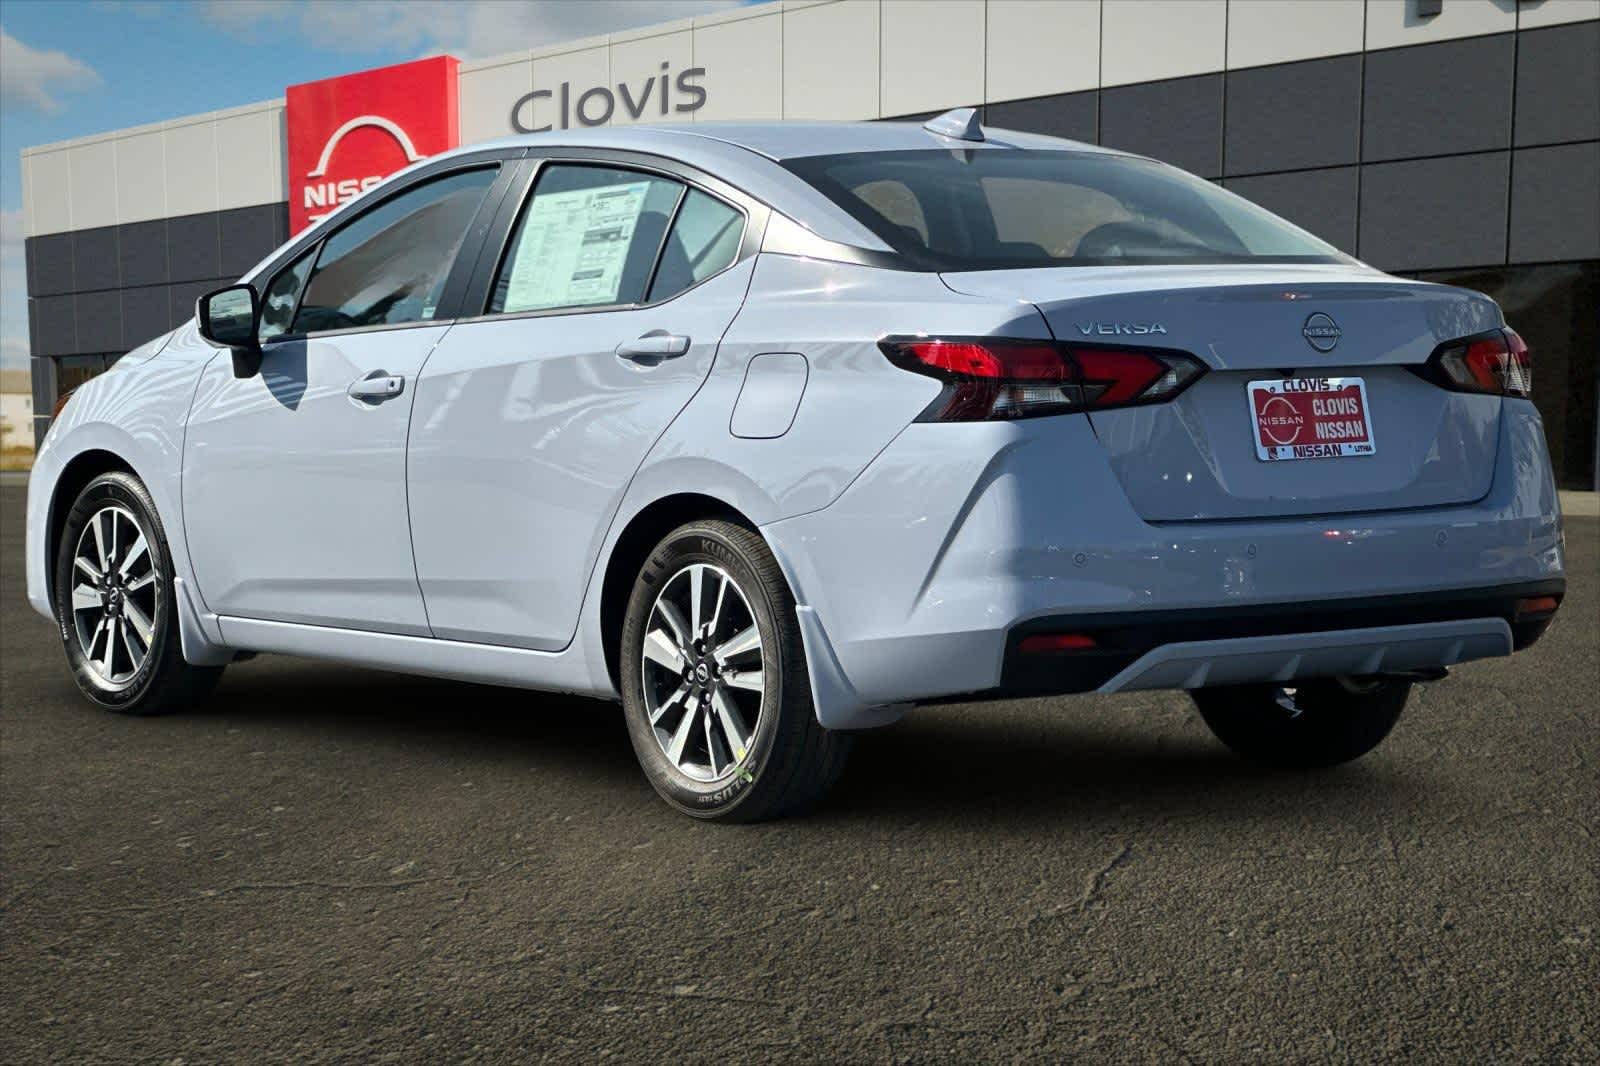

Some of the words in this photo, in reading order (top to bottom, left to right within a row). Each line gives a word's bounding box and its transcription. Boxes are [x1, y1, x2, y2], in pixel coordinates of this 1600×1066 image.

[511, 62, 706, 133] Clovis
[1077, 321, 1167, 336] VERSA
[1283, 379, 1330, 393] CLOVIS
[1312, 397, 1358, 416] CLOVIS
[1259, 416, 1304, 426] NISSAN
[1315, 420, 1364, 440] NISSAN
[1293, 444, 1342, 459] NISSAN
